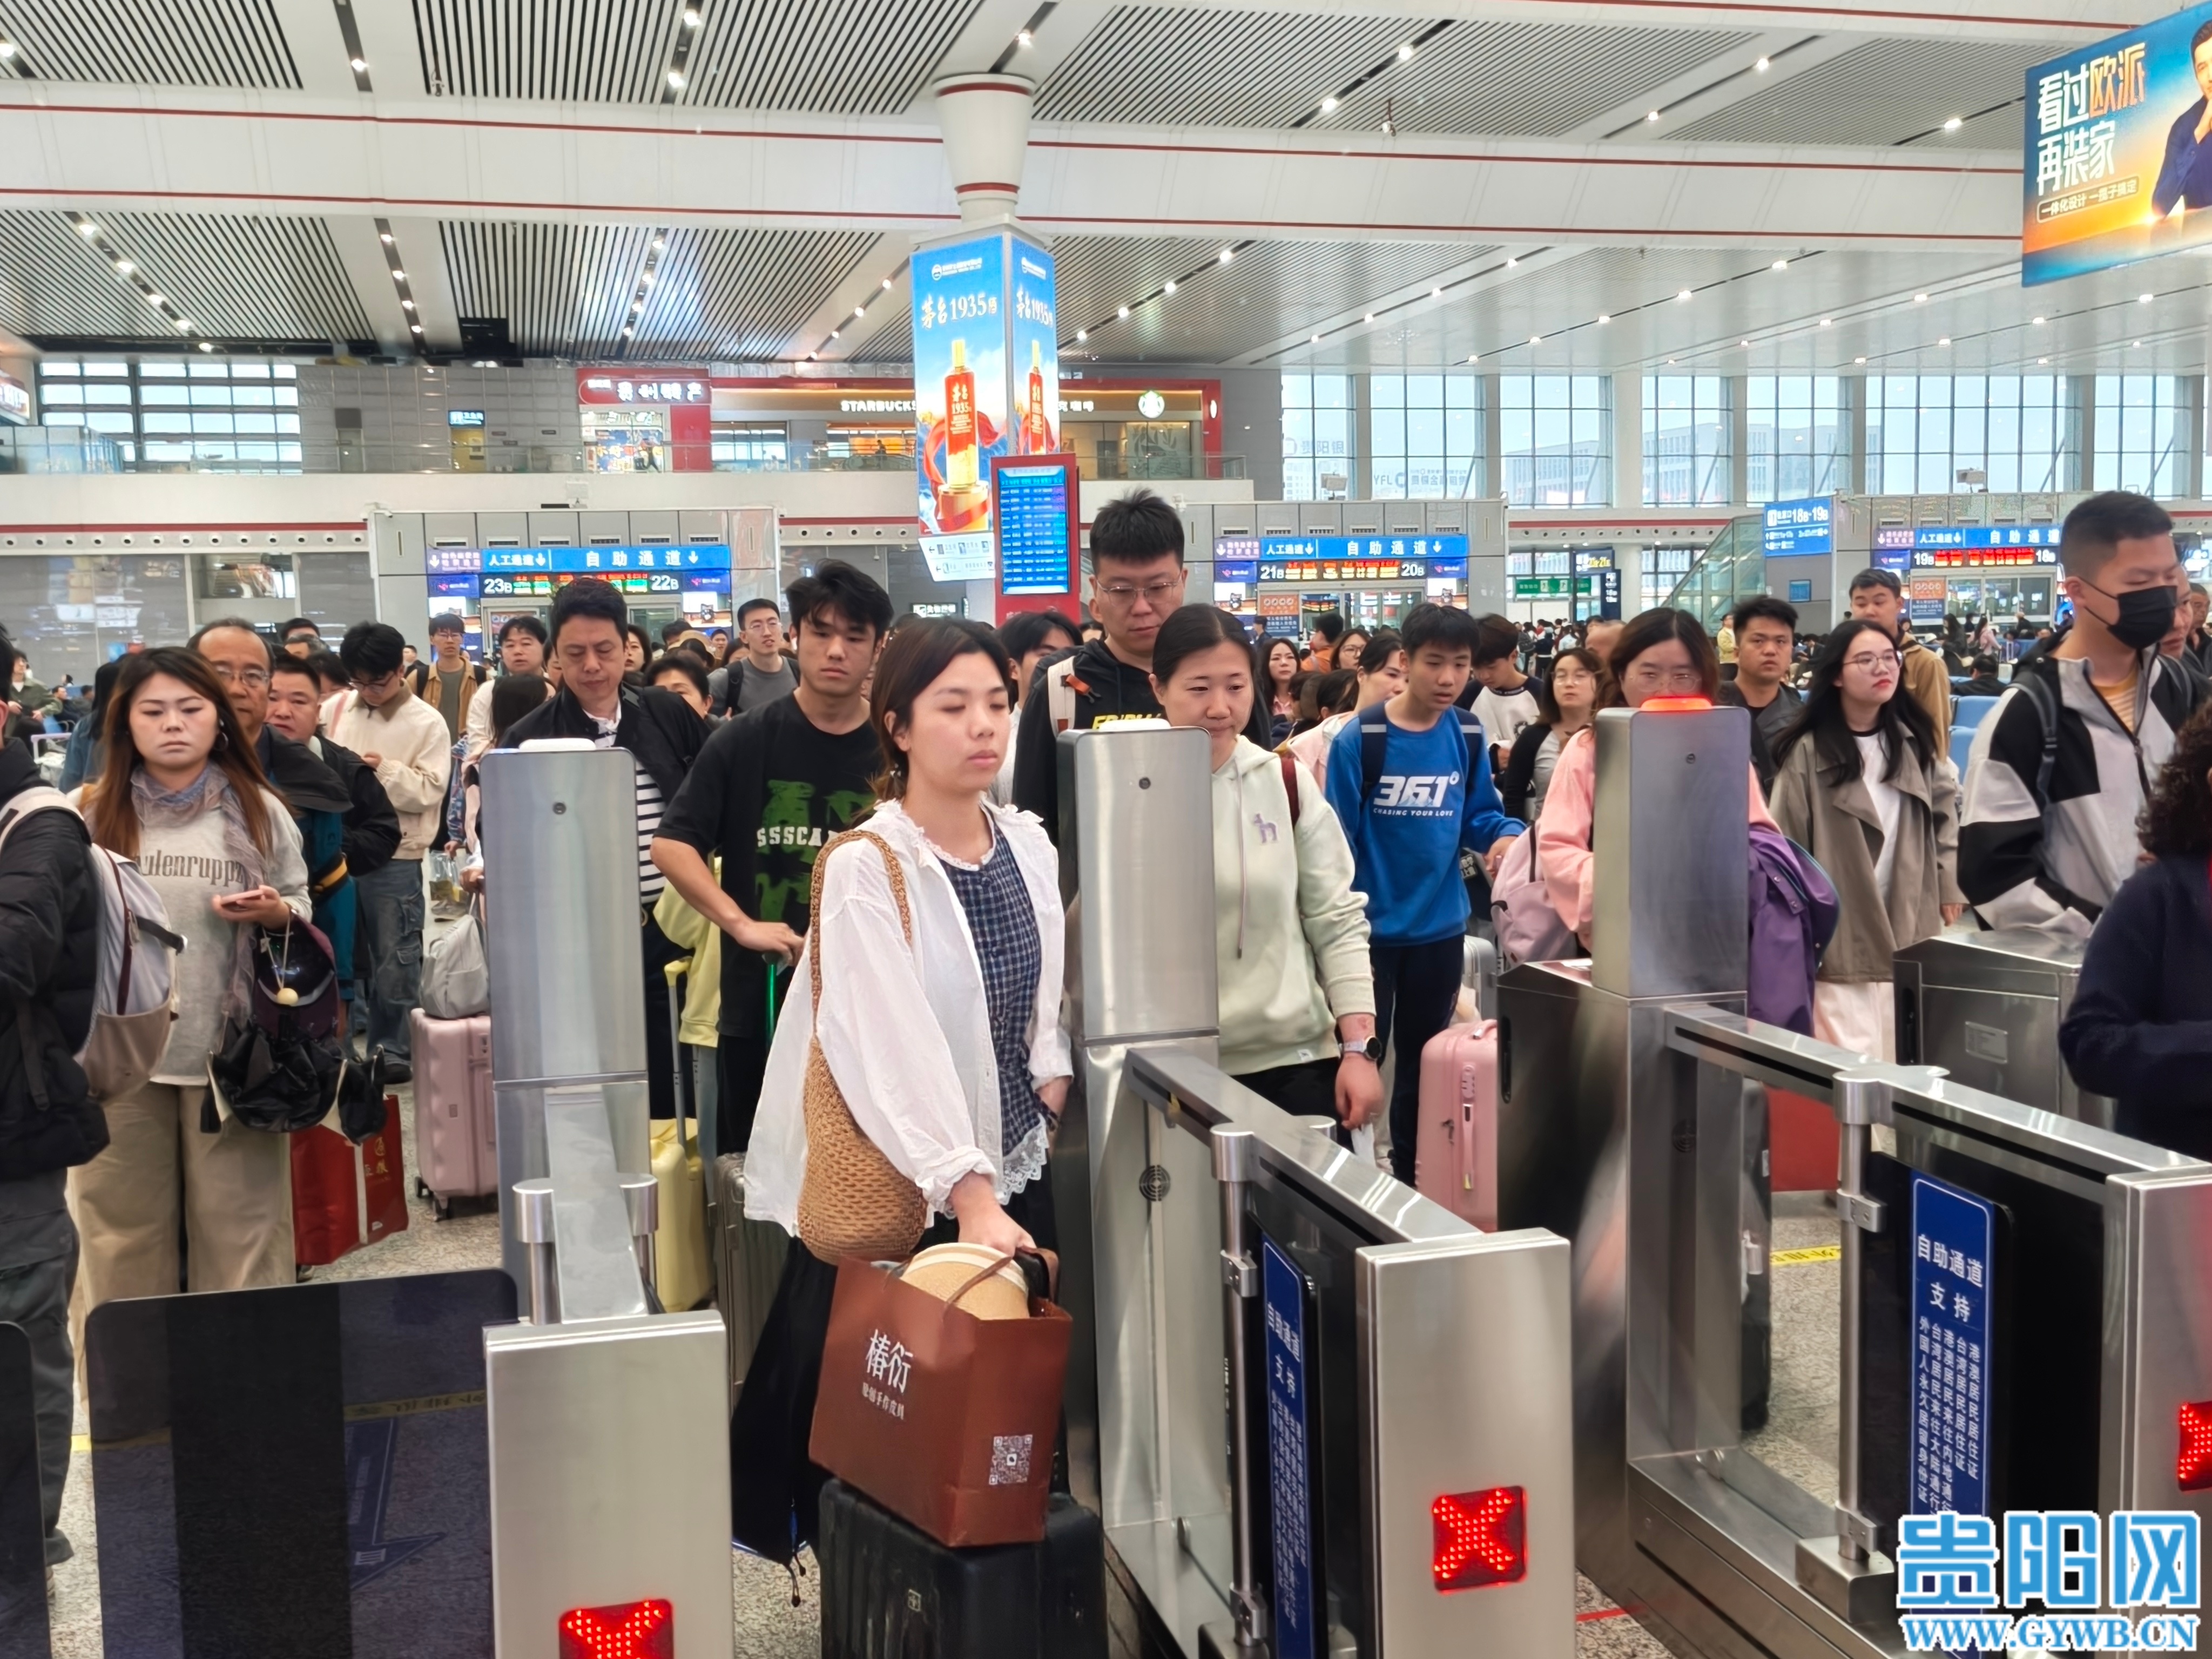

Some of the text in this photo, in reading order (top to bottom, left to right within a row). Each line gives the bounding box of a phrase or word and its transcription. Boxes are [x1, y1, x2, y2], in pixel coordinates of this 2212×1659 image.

[2037, 42, 2146, 135] 看过欧派
[2036, 120, 2116, 197] 再装家
[2041, 193, 2087, 216] 一体化设计
[1347, 541, 1427, 556] 自助通道
[586, 550, 682, 568] 自助通道
[1914, 552, 1934, 565] 19B
[1260, 566, 1285, 579] 21B
[1401, 563, 1425, 577] 20B
[484, 578, 512, 594] 23B
[650, 575, 679, 591] 22B
[1373, 807, 1407, 817] CHASING
[1917, 1233, 1983, 1289] 自助通道
[1930, 1282, 1970, 1323] 支持
[865, 1328, 914, 1394] 椿衍
[1930, 1323, 1942, 1515] 台湾居民来往大陆通行
